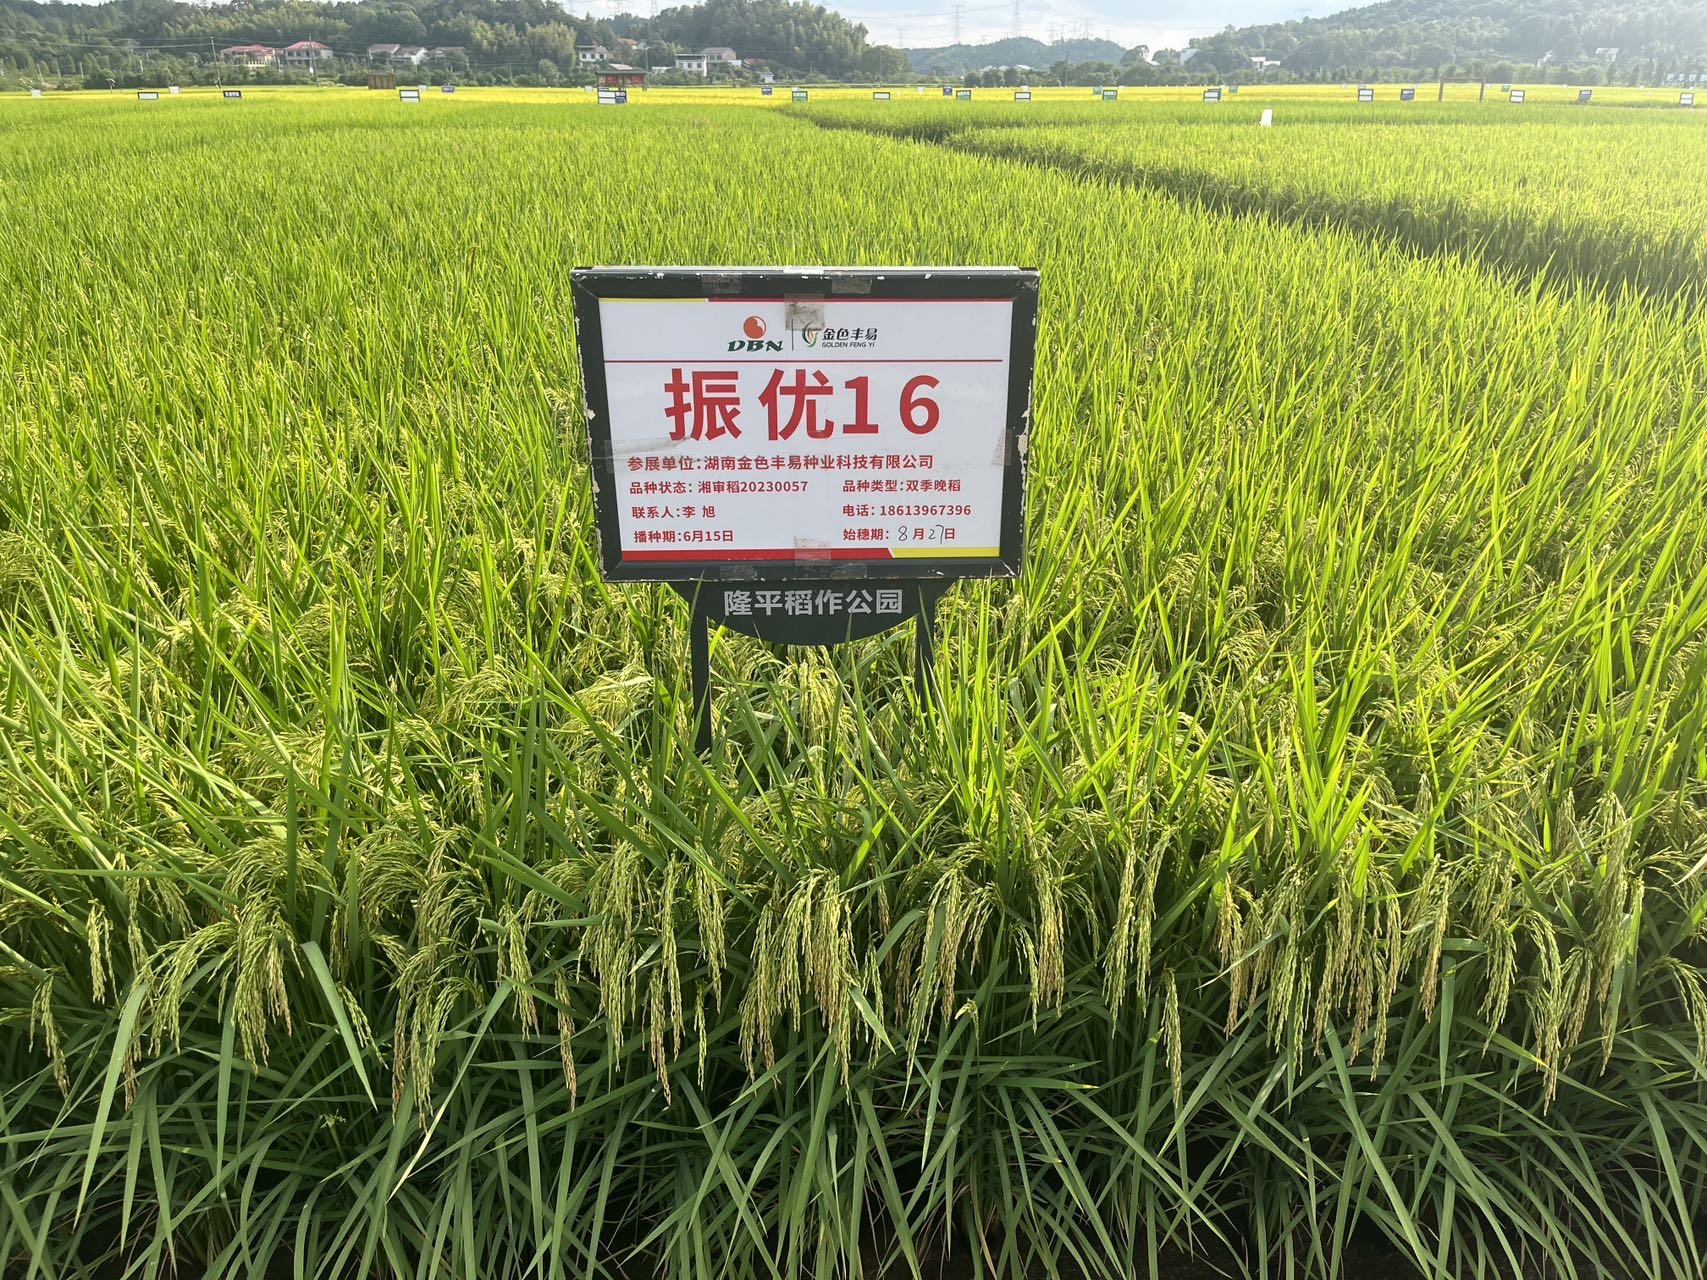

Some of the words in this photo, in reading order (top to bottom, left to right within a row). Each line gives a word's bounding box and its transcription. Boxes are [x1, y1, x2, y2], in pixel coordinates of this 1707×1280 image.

[820, 327, 878, 341] 金色丰易
[727, 339, 784, 352] DBN
[724, 588, 903, 616] 隆平稻作公园
